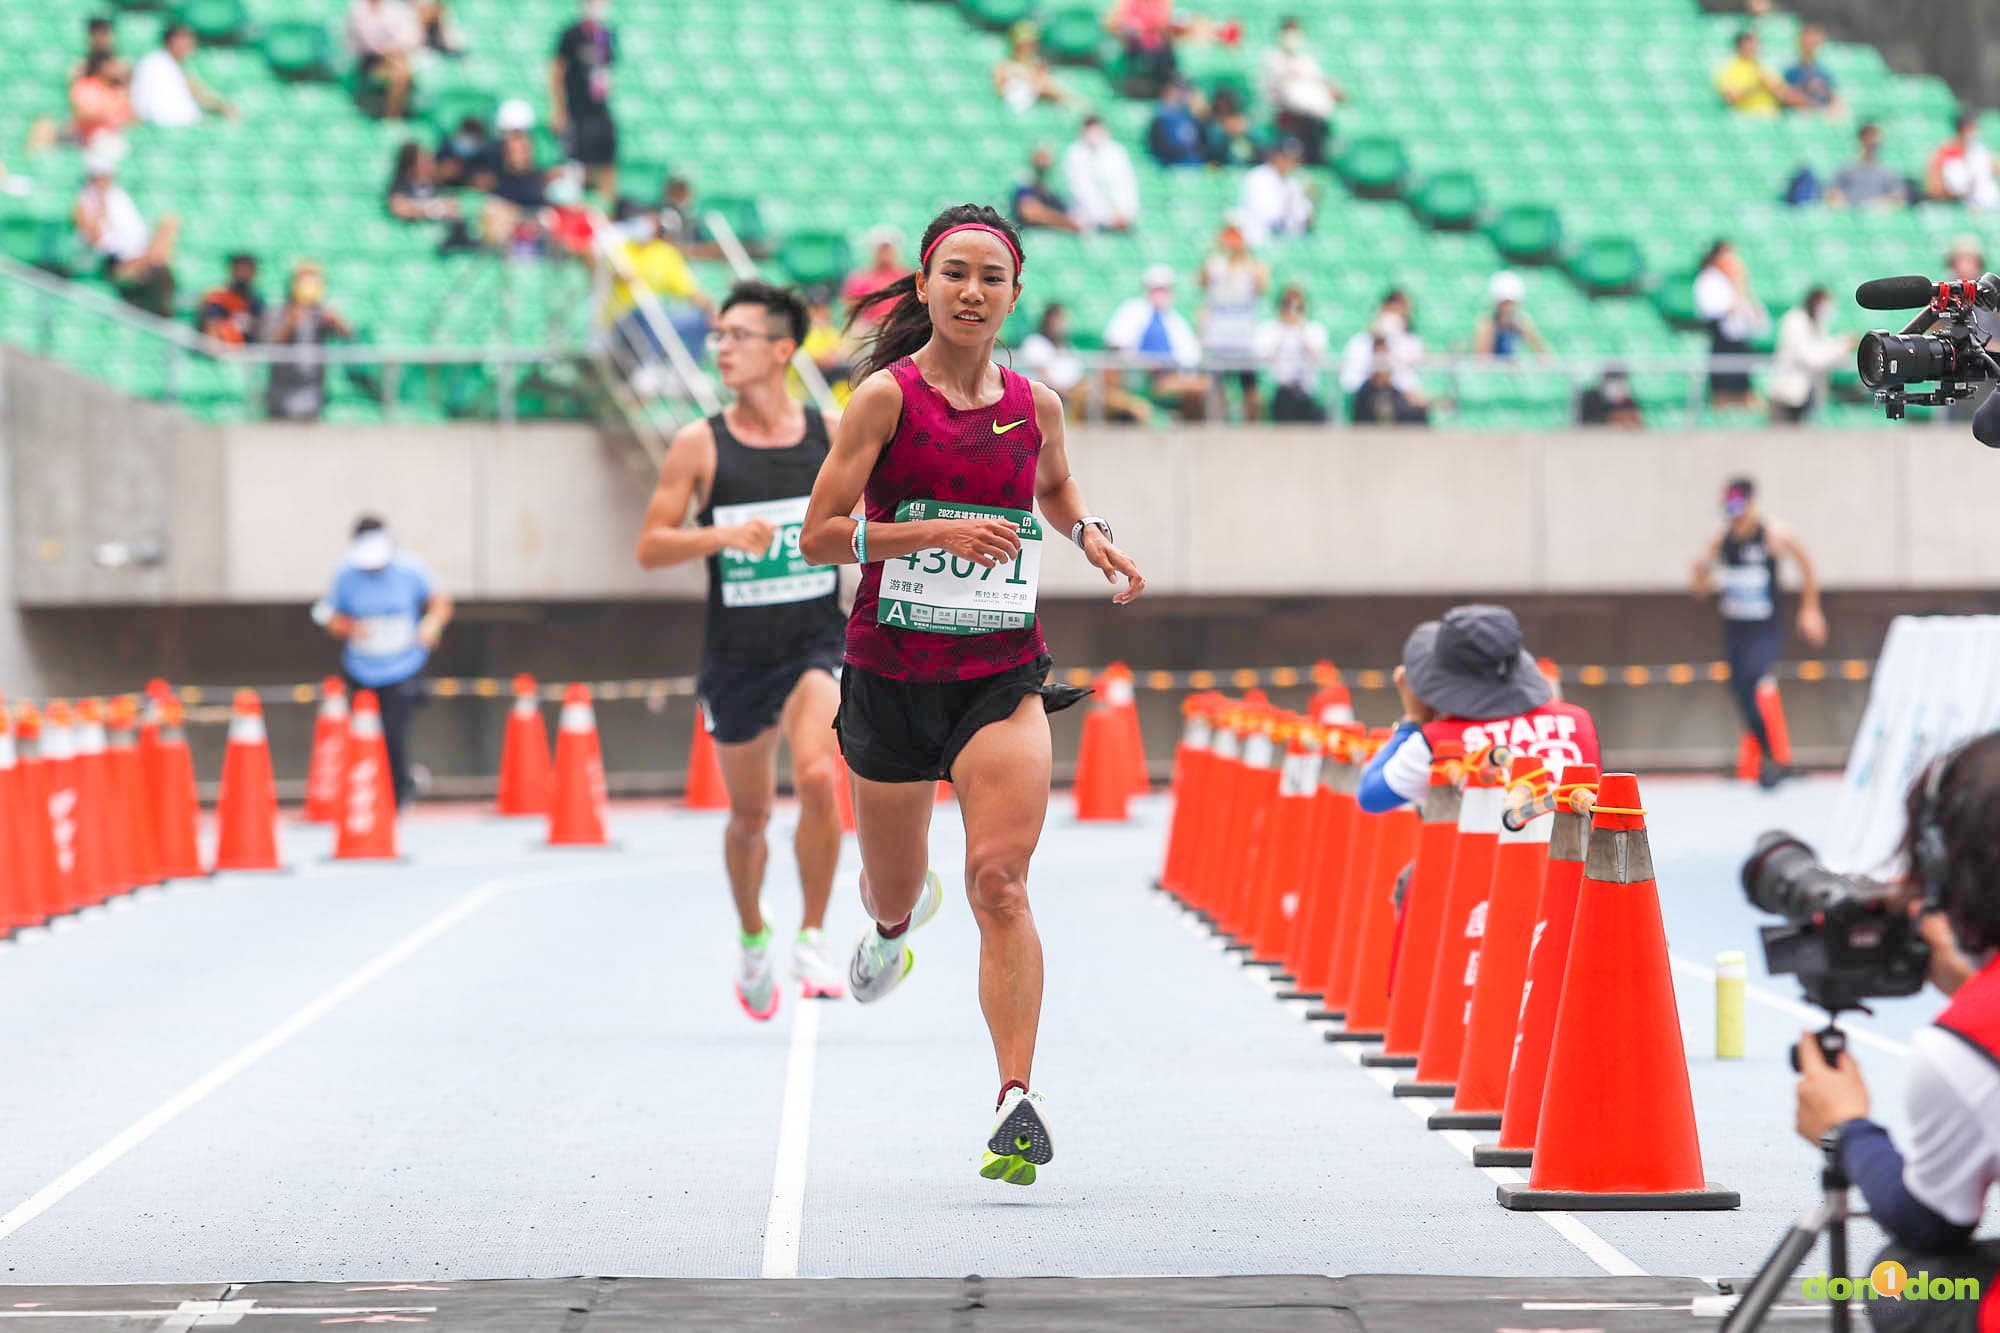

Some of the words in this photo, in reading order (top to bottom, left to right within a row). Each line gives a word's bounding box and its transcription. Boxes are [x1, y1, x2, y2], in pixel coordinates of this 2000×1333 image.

[889, 578, 924, 594] 游雅君
[975, 590, 1000, 599] 馬拉松
[886, 601, 906, 625] A
[1463, 715, 1576, 752] STAFF
